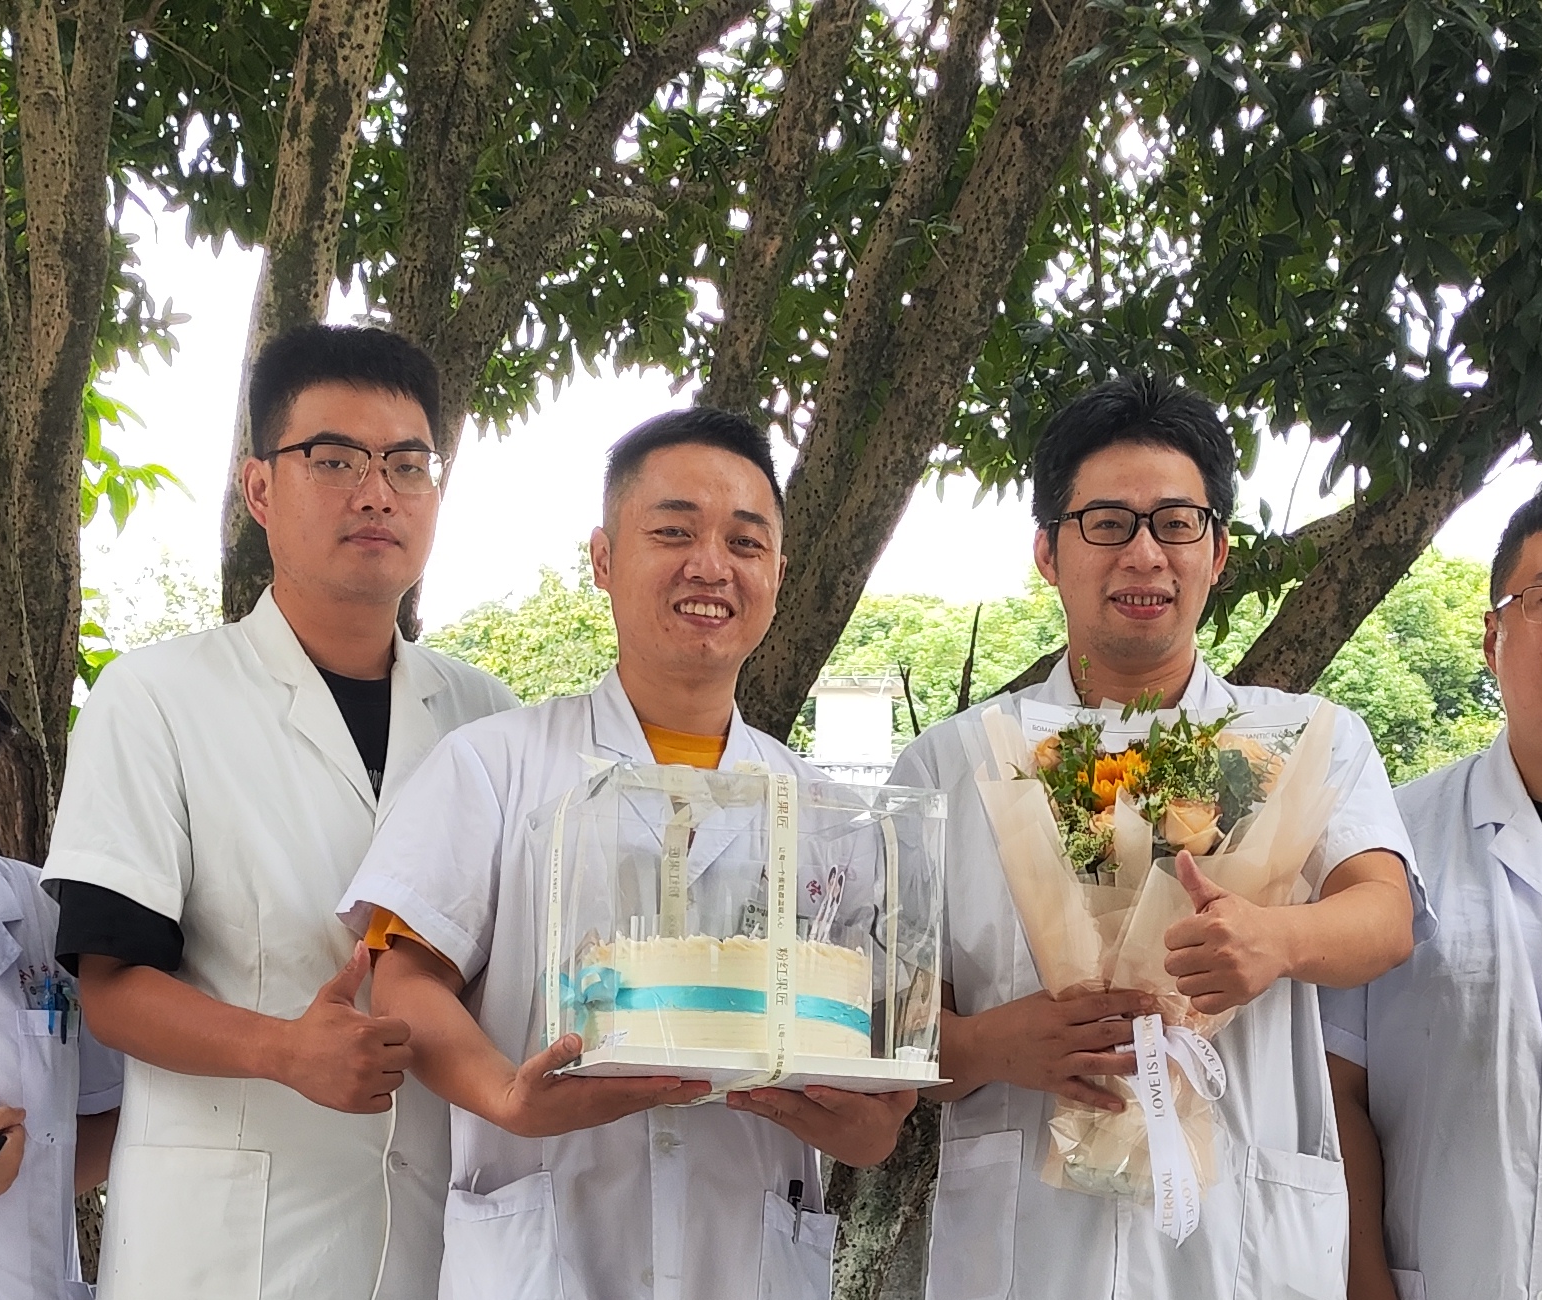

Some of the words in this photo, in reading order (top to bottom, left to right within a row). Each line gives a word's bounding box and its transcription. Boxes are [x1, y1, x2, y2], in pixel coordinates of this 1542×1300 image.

[776, 947, 789, 1006] 粉红果匠
[1147, 1061, 1159, 1076] IS
[1149, 1078, 1165, 1118] LOVE
[1162, 1167, 1174, 1232] TERNAL
